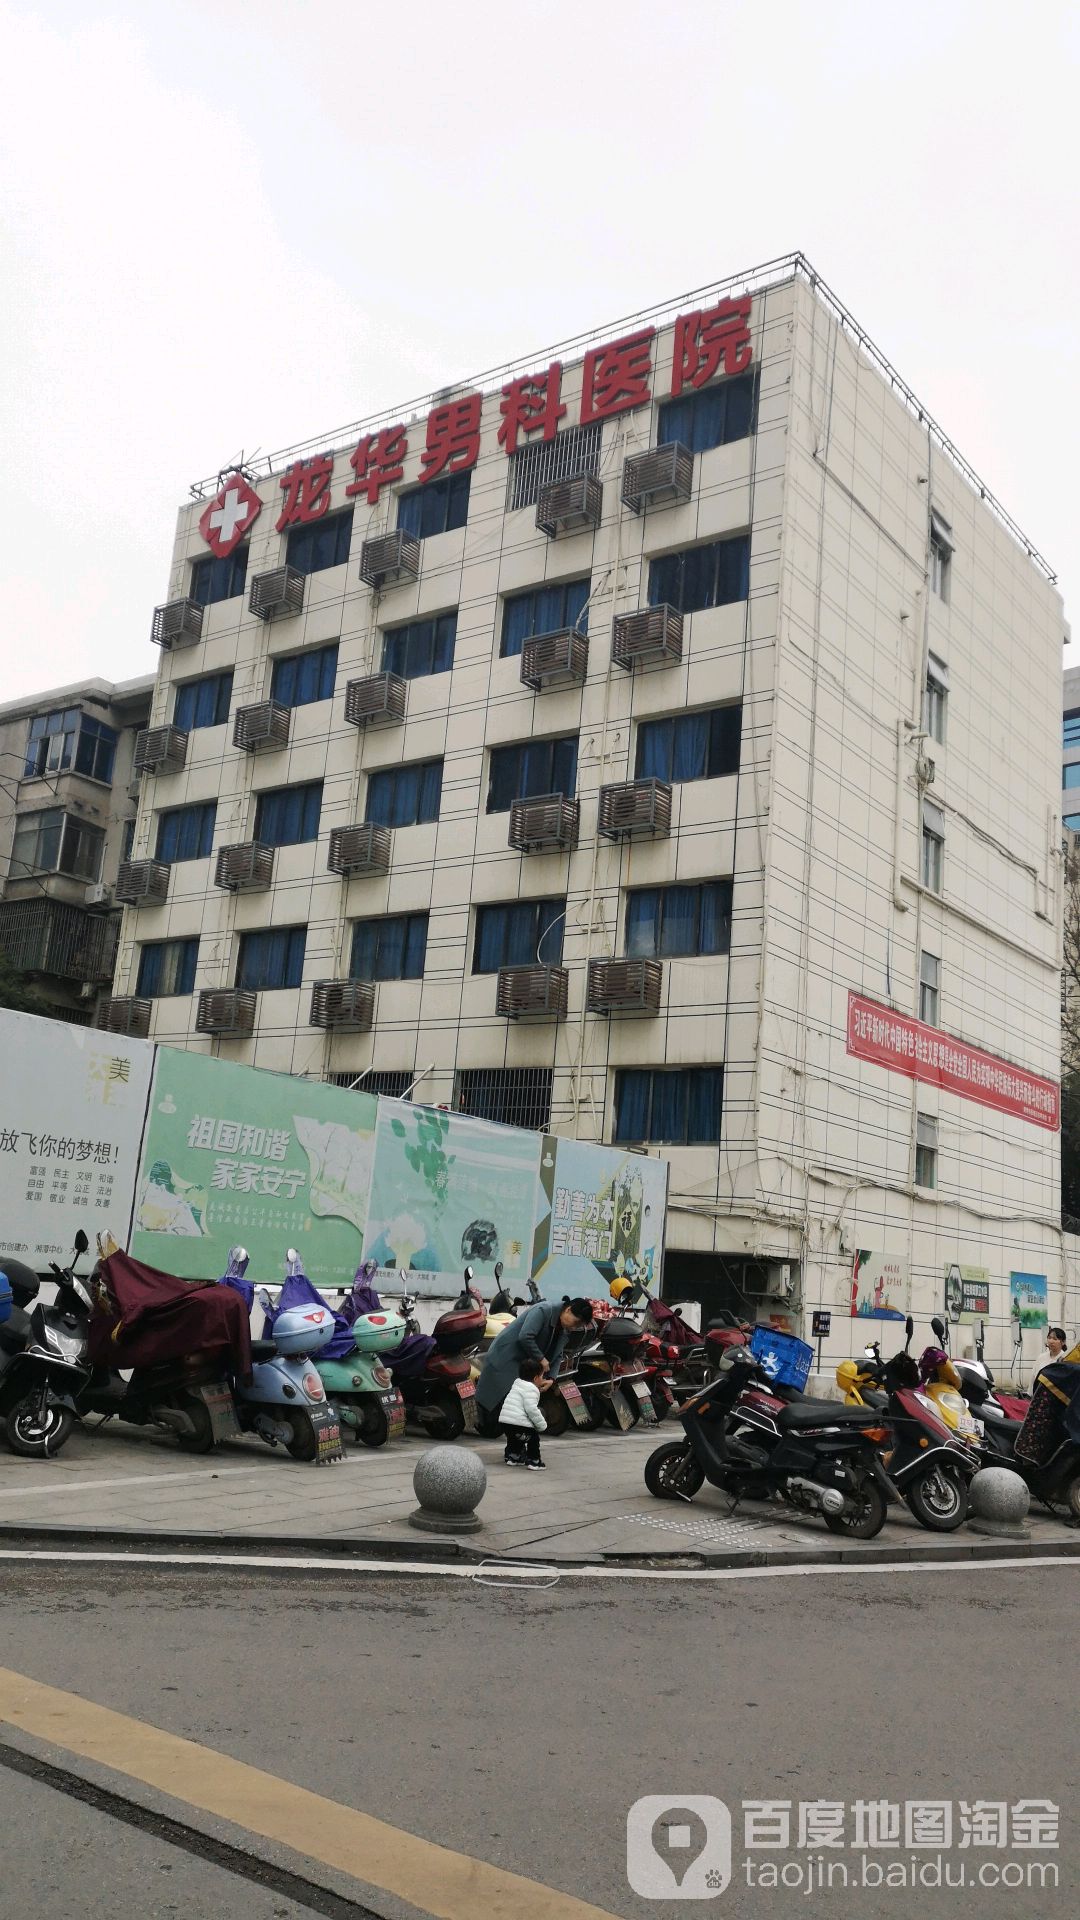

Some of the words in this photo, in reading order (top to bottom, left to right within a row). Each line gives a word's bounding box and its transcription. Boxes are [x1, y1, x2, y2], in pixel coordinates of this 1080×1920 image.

[275, 296, 753, 532] 龙华男科医院
[109, 1056, 131, 1083] 美
[187, 1114, 291, 1162] 祖国和谐
[27, 1178, 45, 1189] 自由
[52, 1181, 68, 1191] 平等
[74, 1183, 90, 1194] 公正
[96, 1186, 112, 1196] 法治
[29, 1165, 47, 1177] 富强
[53, 1168, 70, 1179] 民主
[76, 1171, 92, 1182] 文明
[98, 1173, 114, 1184] 和谐
[210, 1158, 307, 1199] 家家安宁
[25, 1190, 43, 1201] 爱国
[49, 1193, 66, 1204] 敬业
[72, 1196, 89, 1206] 诚信
[94, 1198, 111, 1208] 友善
